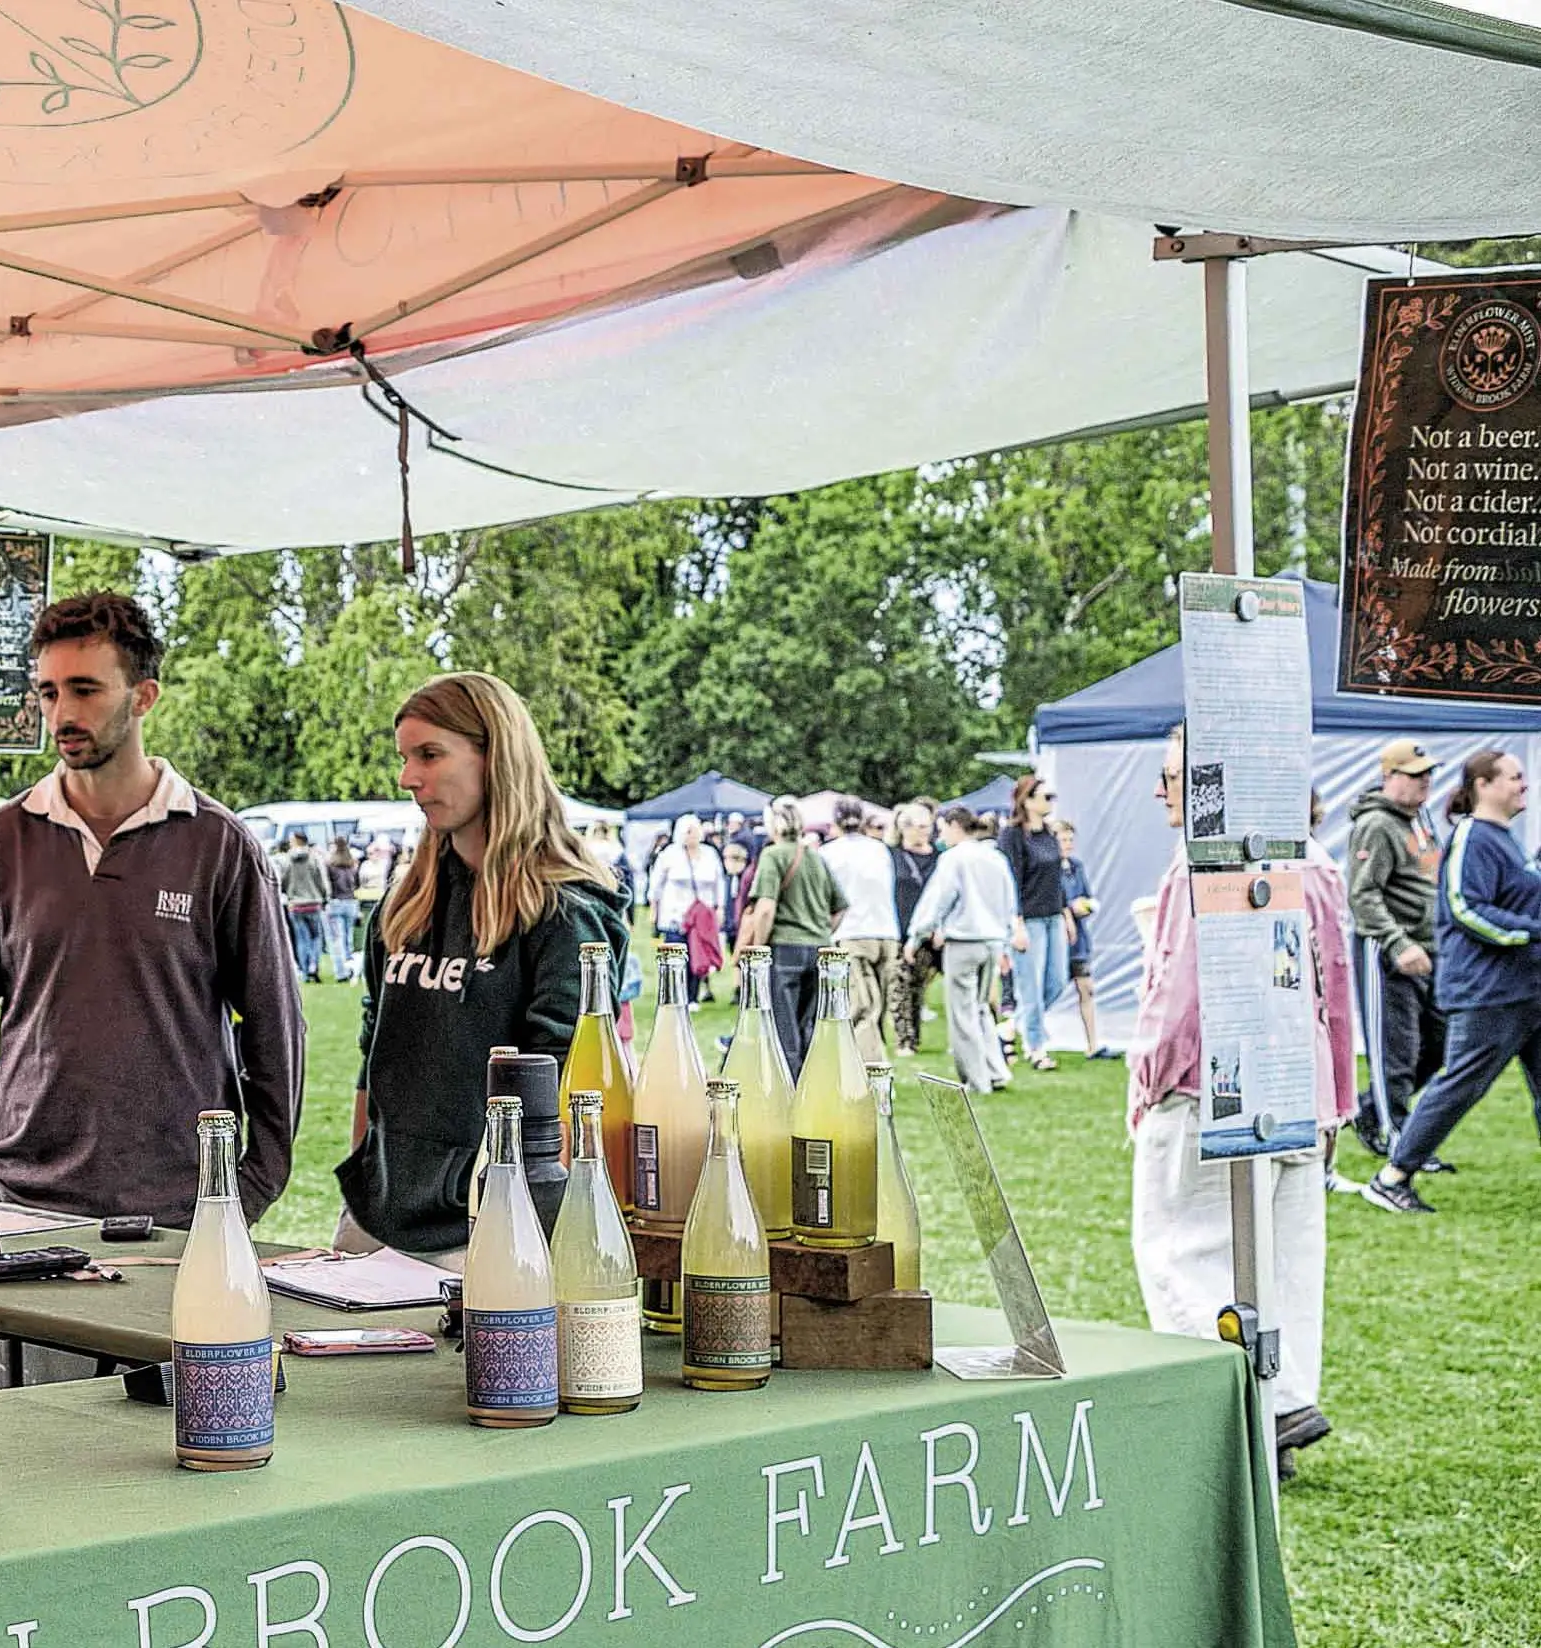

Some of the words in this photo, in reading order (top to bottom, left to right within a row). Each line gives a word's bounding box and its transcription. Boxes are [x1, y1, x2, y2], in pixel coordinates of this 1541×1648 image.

[1518, 319, 1536, 348] MIST
[1410, 425, 1453, 448] Not
[1458, 430, 1471, 448] a
[1407, 458, 1450, 481] Not
[1454, 463, 1467, 481] a
[1404, 489, 1447, 512] Not
[1450, 495, 1463, 512] a
[1402, 520, 1444, 544] Not
[1389, 557, 1441, 579] Made
[1439, 558, 1498, 586] from
[384, 950, 467, 992] true
[474, 1314, 540, 1325] ELDERFLOWER
[185, 1346, 256, 1359] ELDERFLOWER
[512, 1393, 543, 1404] BROOK
[187, 1434, 224, 1445] WIDDEN
[226, 1432, 259, 1444] BROOK
[760, 1399, 1105, 1585] FARM
